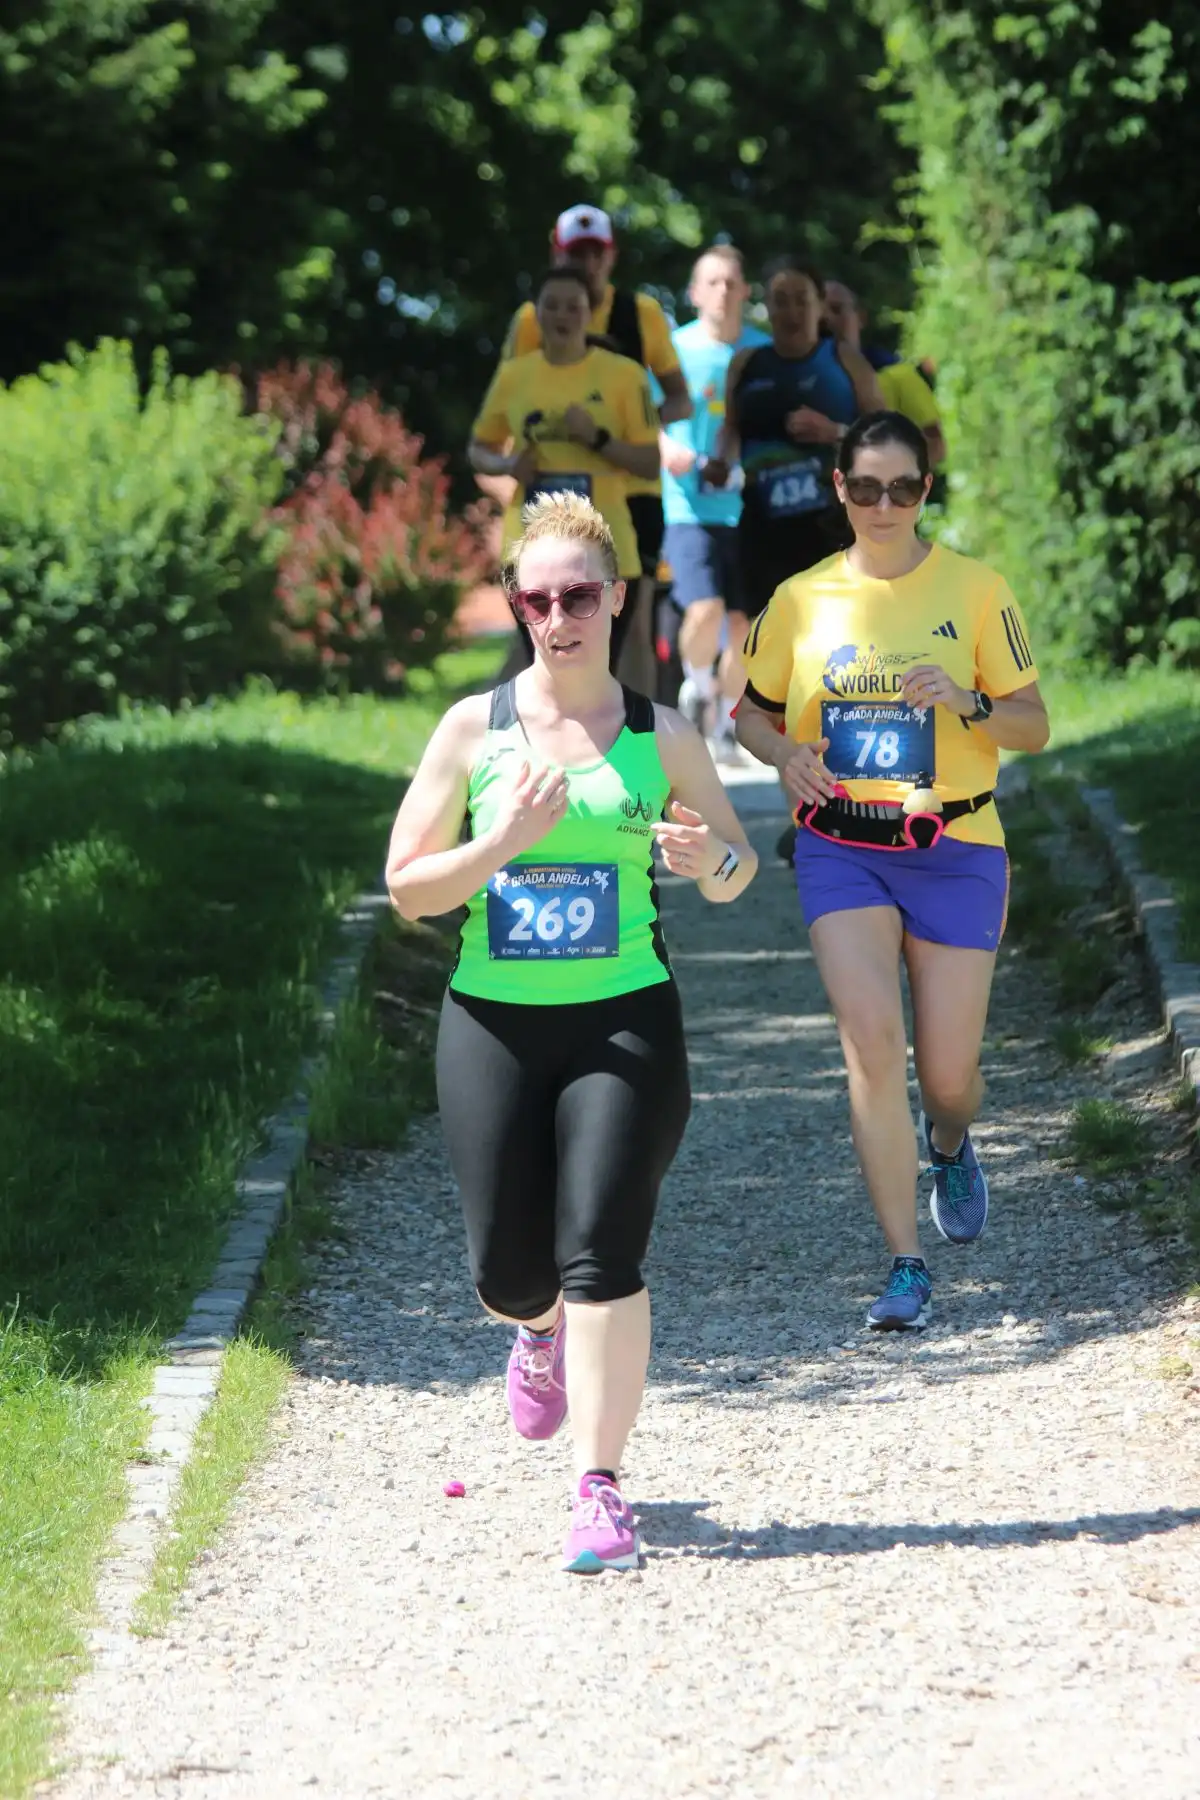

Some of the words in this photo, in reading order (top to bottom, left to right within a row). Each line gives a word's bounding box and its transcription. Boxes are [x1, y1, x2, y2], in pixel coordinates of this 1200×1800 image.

[770, 475, 818, 506] 434
[841, 674, 902, 694] WORLD
[843, 709, 873, 722] GRADA
[855, 730, 900, 768] 78
[511, 872, 545, 888] GRADA
[508, 896, 595, 941] 269
